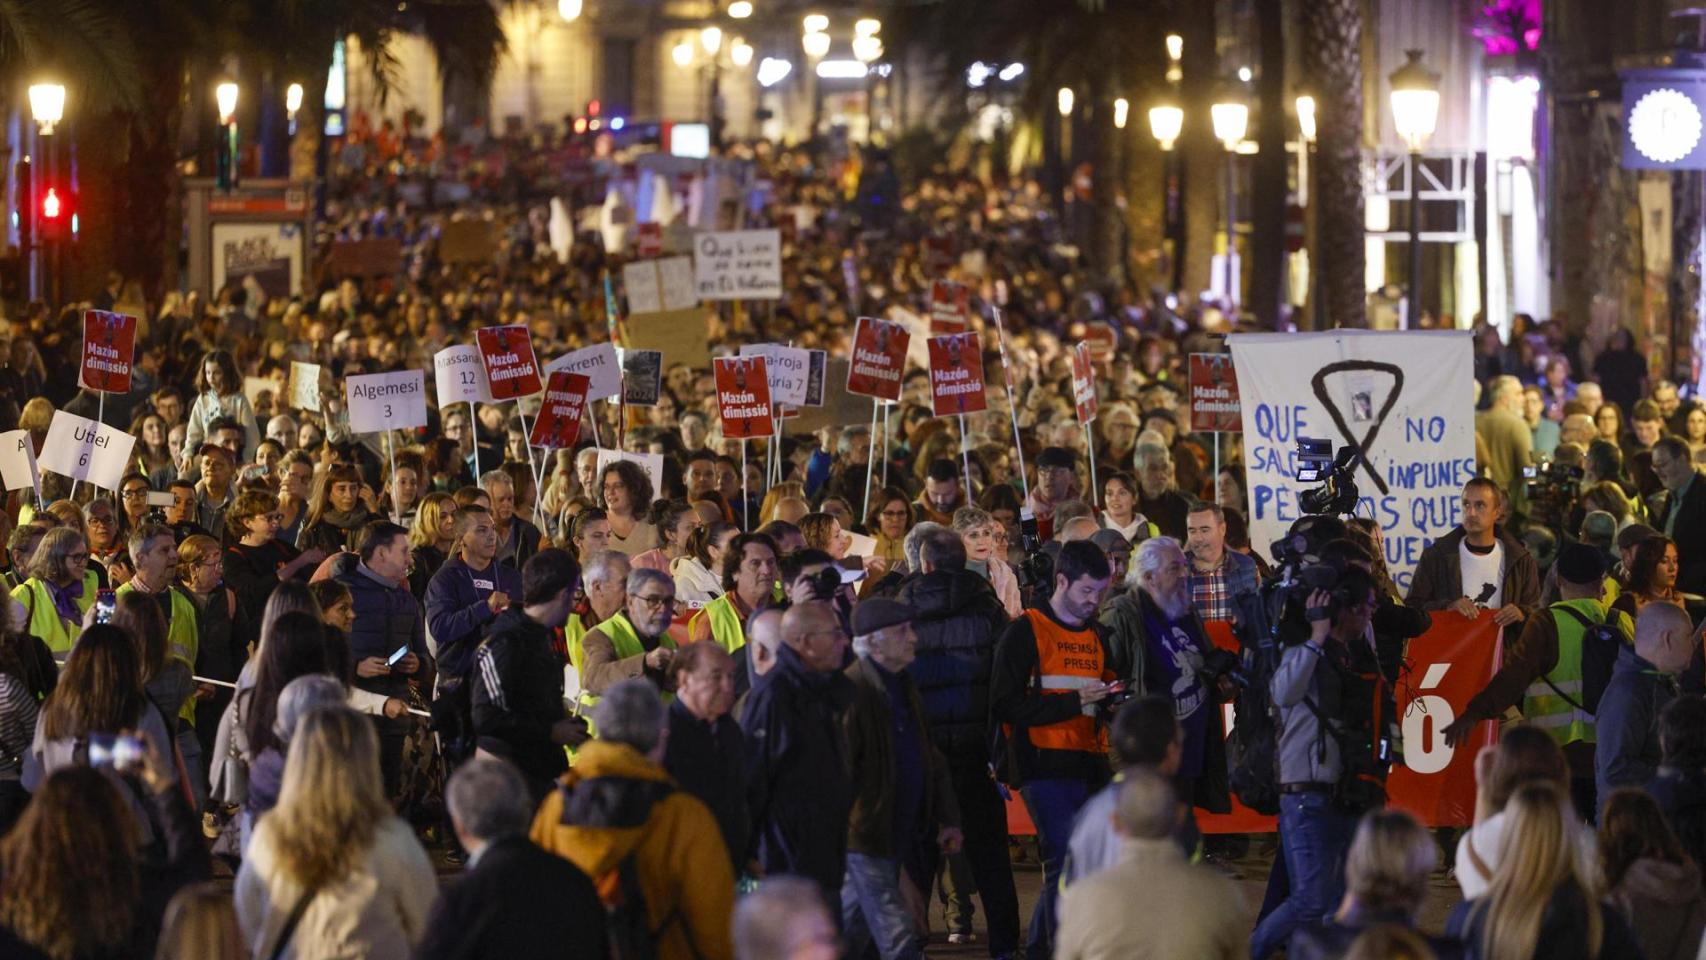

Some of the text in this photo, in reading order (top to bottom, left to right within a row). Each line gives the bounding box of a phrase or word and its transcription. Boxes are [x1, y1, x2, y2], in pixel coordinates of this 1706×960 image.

[87, 342, 119, 359] Mazón
[855, 348, 891, 366] Mazón
[86, 357, 129, 375] dimissió
[487, 352, 519, 367] Mazón
[460, 371, 476, 385] 12
[490, 362, 534, 380] dimissió
[854, 362, 900, 381] dimissió
[934, 367, 969, 382] Mazón
[353, 378, 418, 400] Algemesí
[796, 378, 804, 391] 7
[935, 379, 981, 396] dimissió
[1193, 385, 1229, 398] Mazón
[721, 390, 755, 404] Mazón
[384, 404, 393, 418] 3
[723, 403, 769, 418] dimissió
[1193, 399, 1240, 412] dimissió
[1255, 404, 1446, 443] QUE NO
[74, 427, 110, 448] Utiel
[79, 453, 88, 466] 6
[1412, 496, 1462, 533] QUE
[1063, 657, 1098, 671] PRESS
